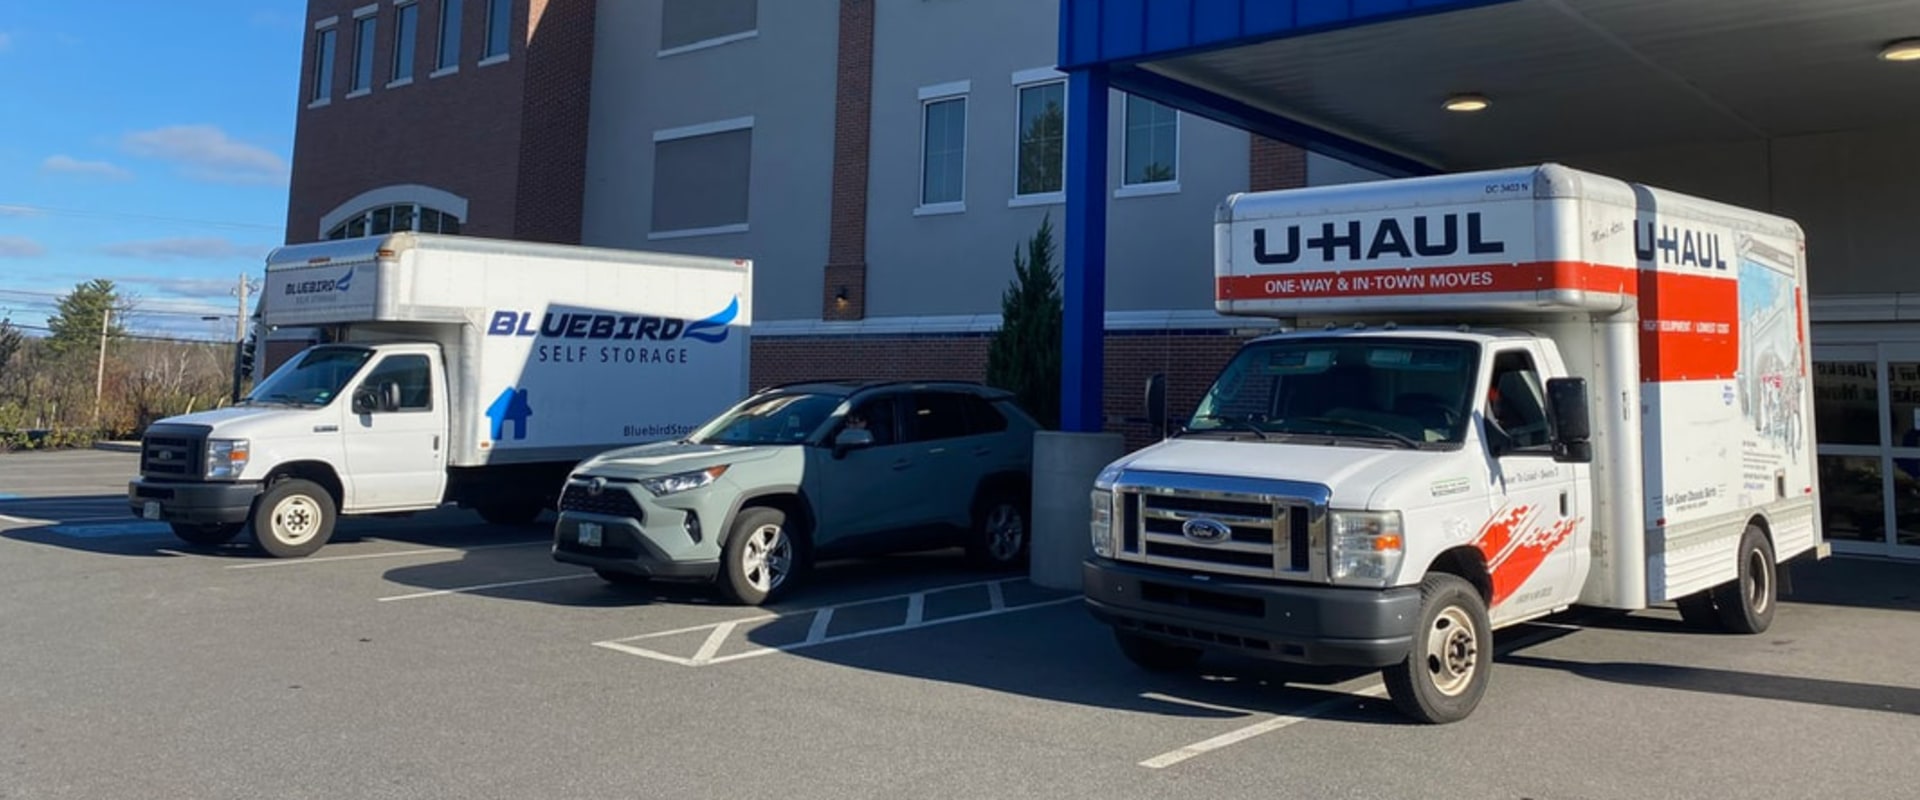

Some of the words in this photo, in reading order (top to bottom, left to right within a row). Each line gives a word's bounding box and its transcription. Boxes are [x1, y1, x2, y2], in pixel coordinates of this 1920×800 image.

[285, 279, 335, 295] BLUEBIRD
[1265, 278, 1333, 294] ONE-WAY
[1337, 277, 1349, 292] &
[1353, 274, 1425, 291] IN-TOWN
[1429, 271, 1493, 288] MOVES
[487, 310, 684, 341] BLUEBIRD
[539, 345, 588, 363] SELF
[600, 347, 688, 364] STORAGE
